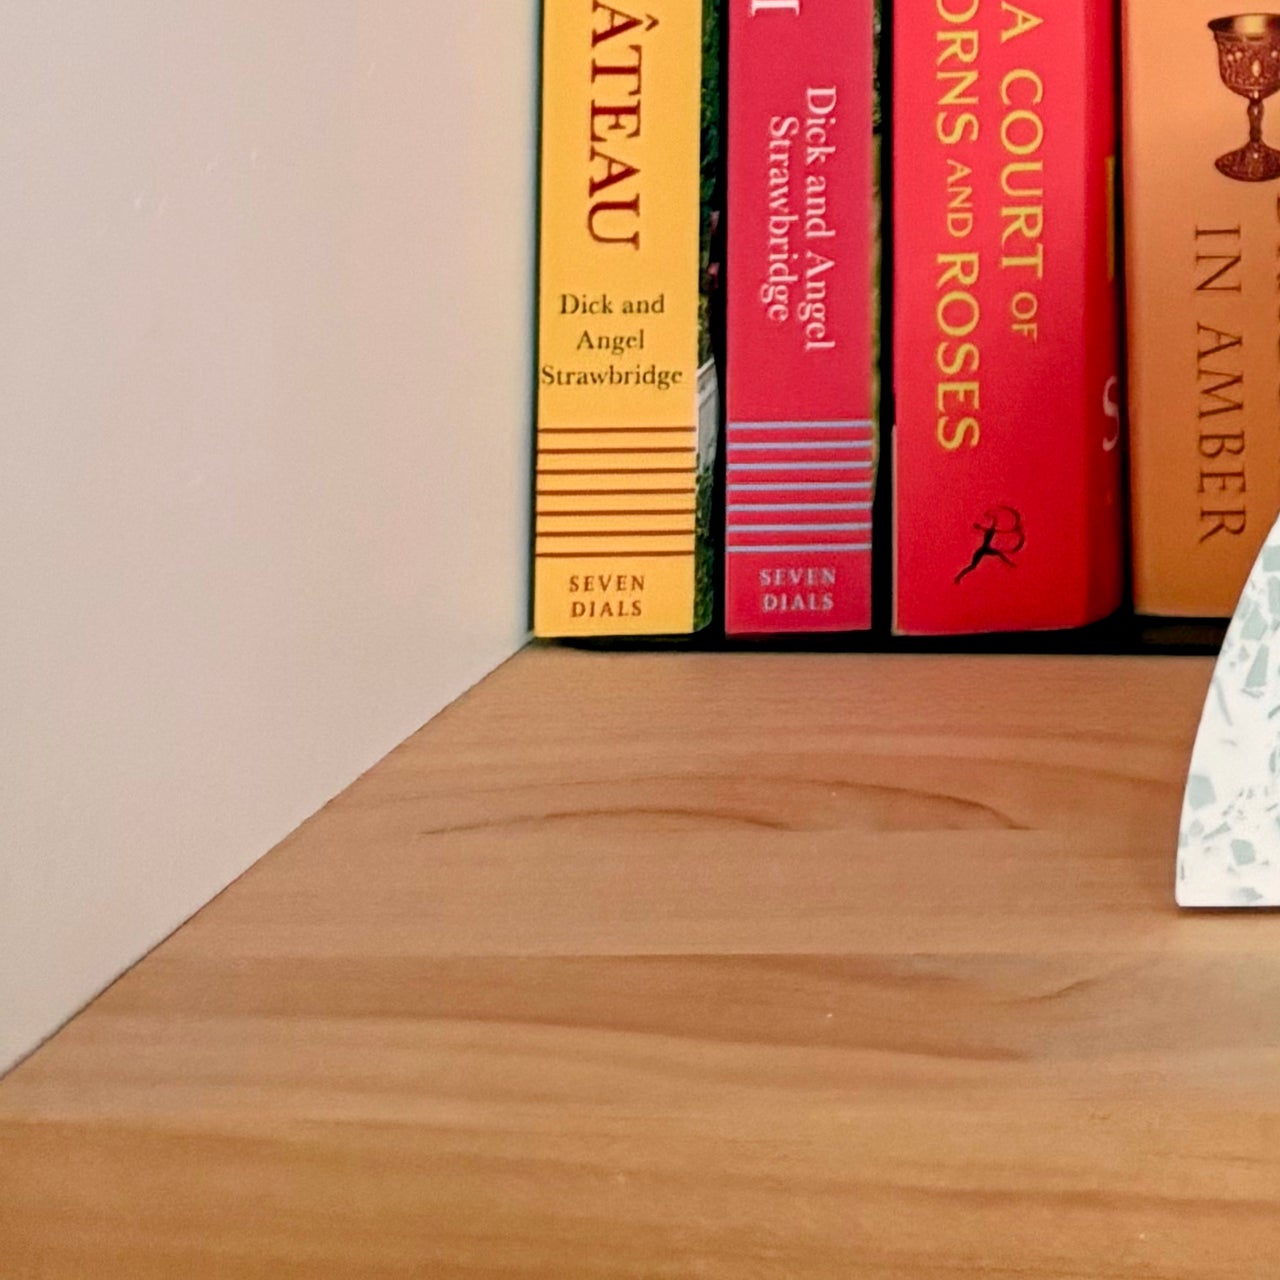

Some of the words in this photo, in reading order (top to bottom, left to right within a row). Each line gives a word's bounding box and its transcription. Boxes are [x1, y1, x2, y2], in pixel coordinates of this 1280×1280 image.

[1001, 0, 1044, 43] A
[805, 85, 837, 165] Dick
[946, 159, 974, 238] AND
[1000, 68, 1044, 279] COURT
[760, 115, 799, 322] Strawbridge
[805, 175, 836, 240] and
[1195, 225, 1242, 293] IN
[560, 293, 613, 314] Dick
[622, 293, 665, 314] and
[797, 250, 836, 352] Angel
[1010, 292, 1038, 343] OF
[576, 329, 644, 356] Angel
[936, 251, 980, 453] ROSES
[541, 364, 683, 390] Strawbridge
[1196, 322, 1246, 544] AMBER
[569, 574, 645, 592] SEVEN
[759, 567, 836, 586] SEVEN
[761, 592, 834, 612] DIALS
[570, 599, 642, 617] DIALS
